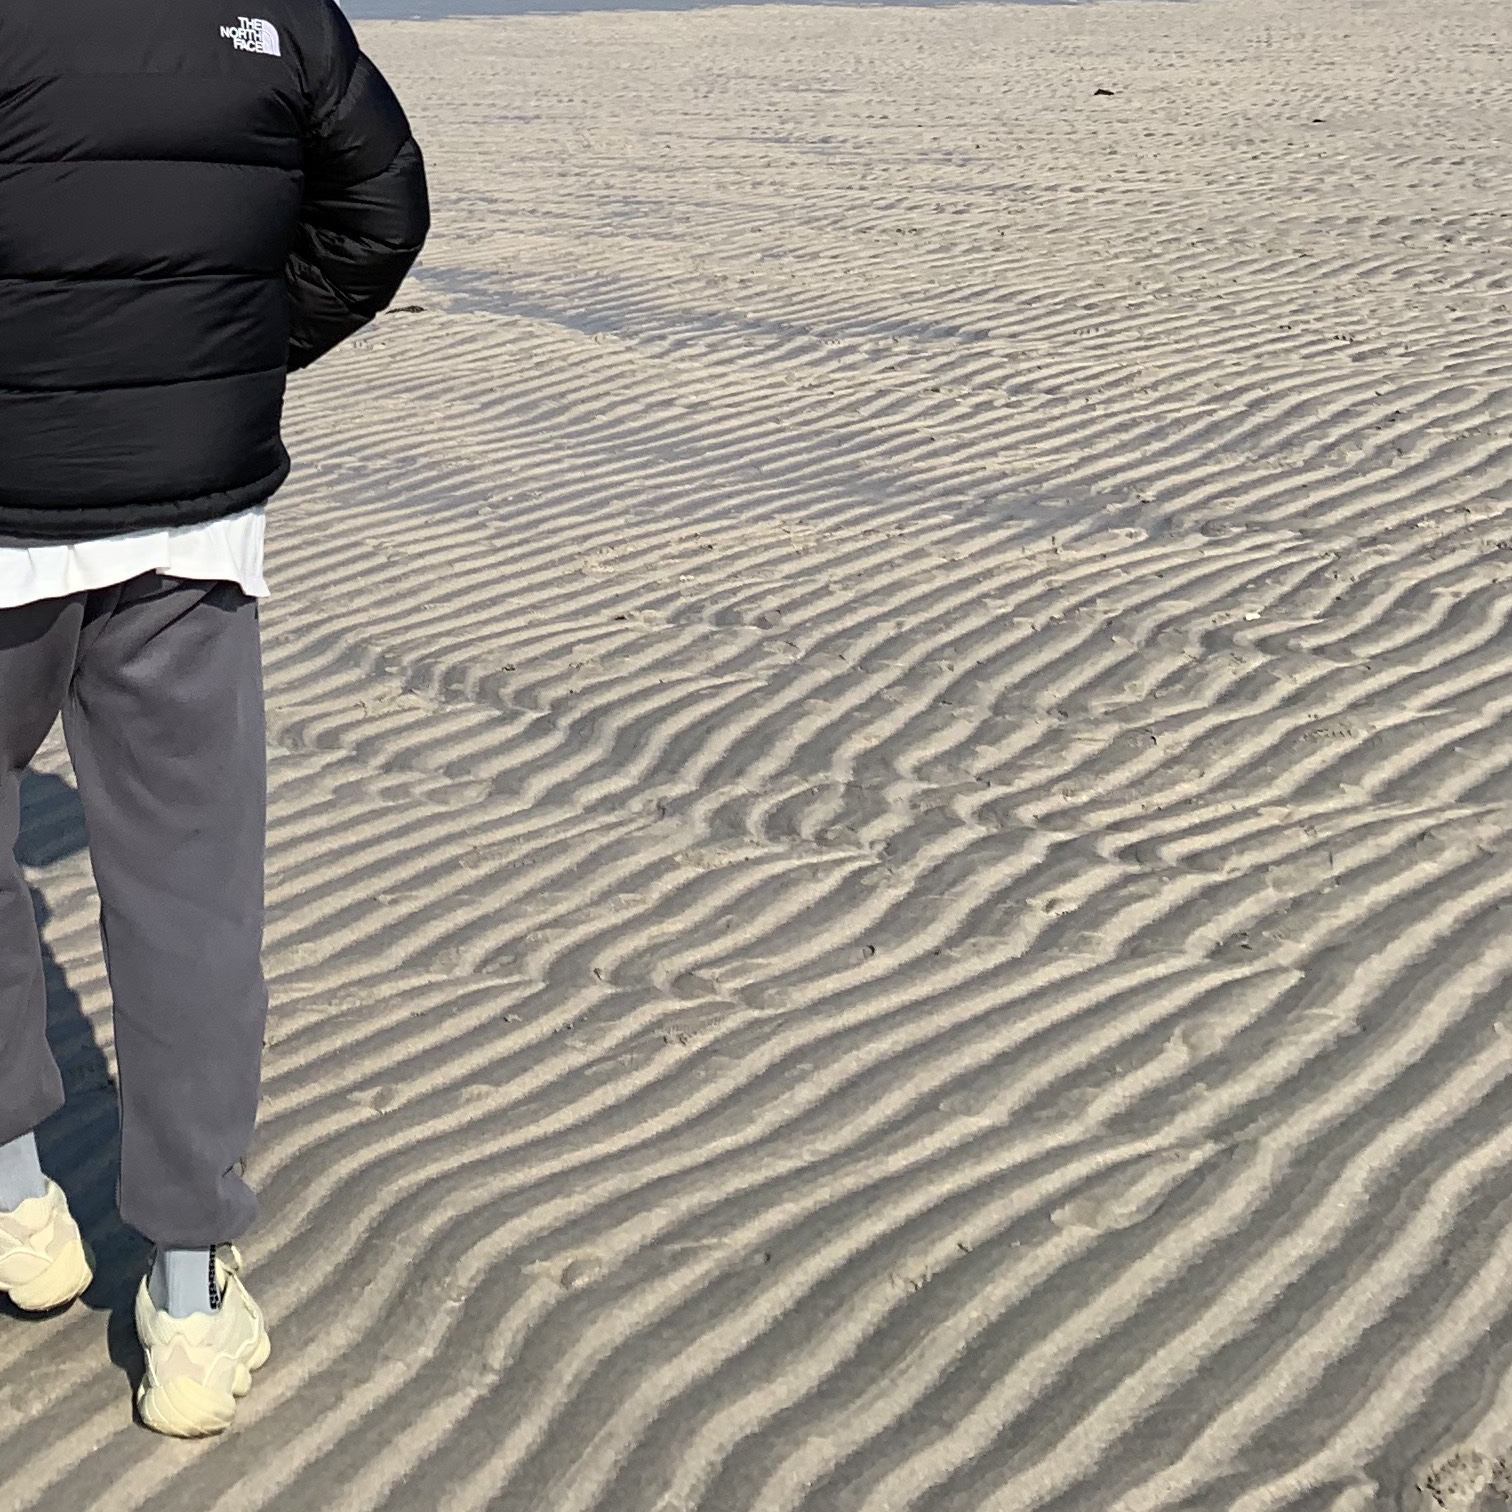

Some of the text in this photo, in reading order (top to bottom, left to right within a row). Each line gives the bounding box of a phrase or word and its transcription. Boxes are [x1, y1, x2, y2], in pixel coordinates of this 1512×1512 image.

[237, 16, 262, 31] THE
[219, 25, 262, 42] NORTH
[233, 38, 264, 54] FACE
